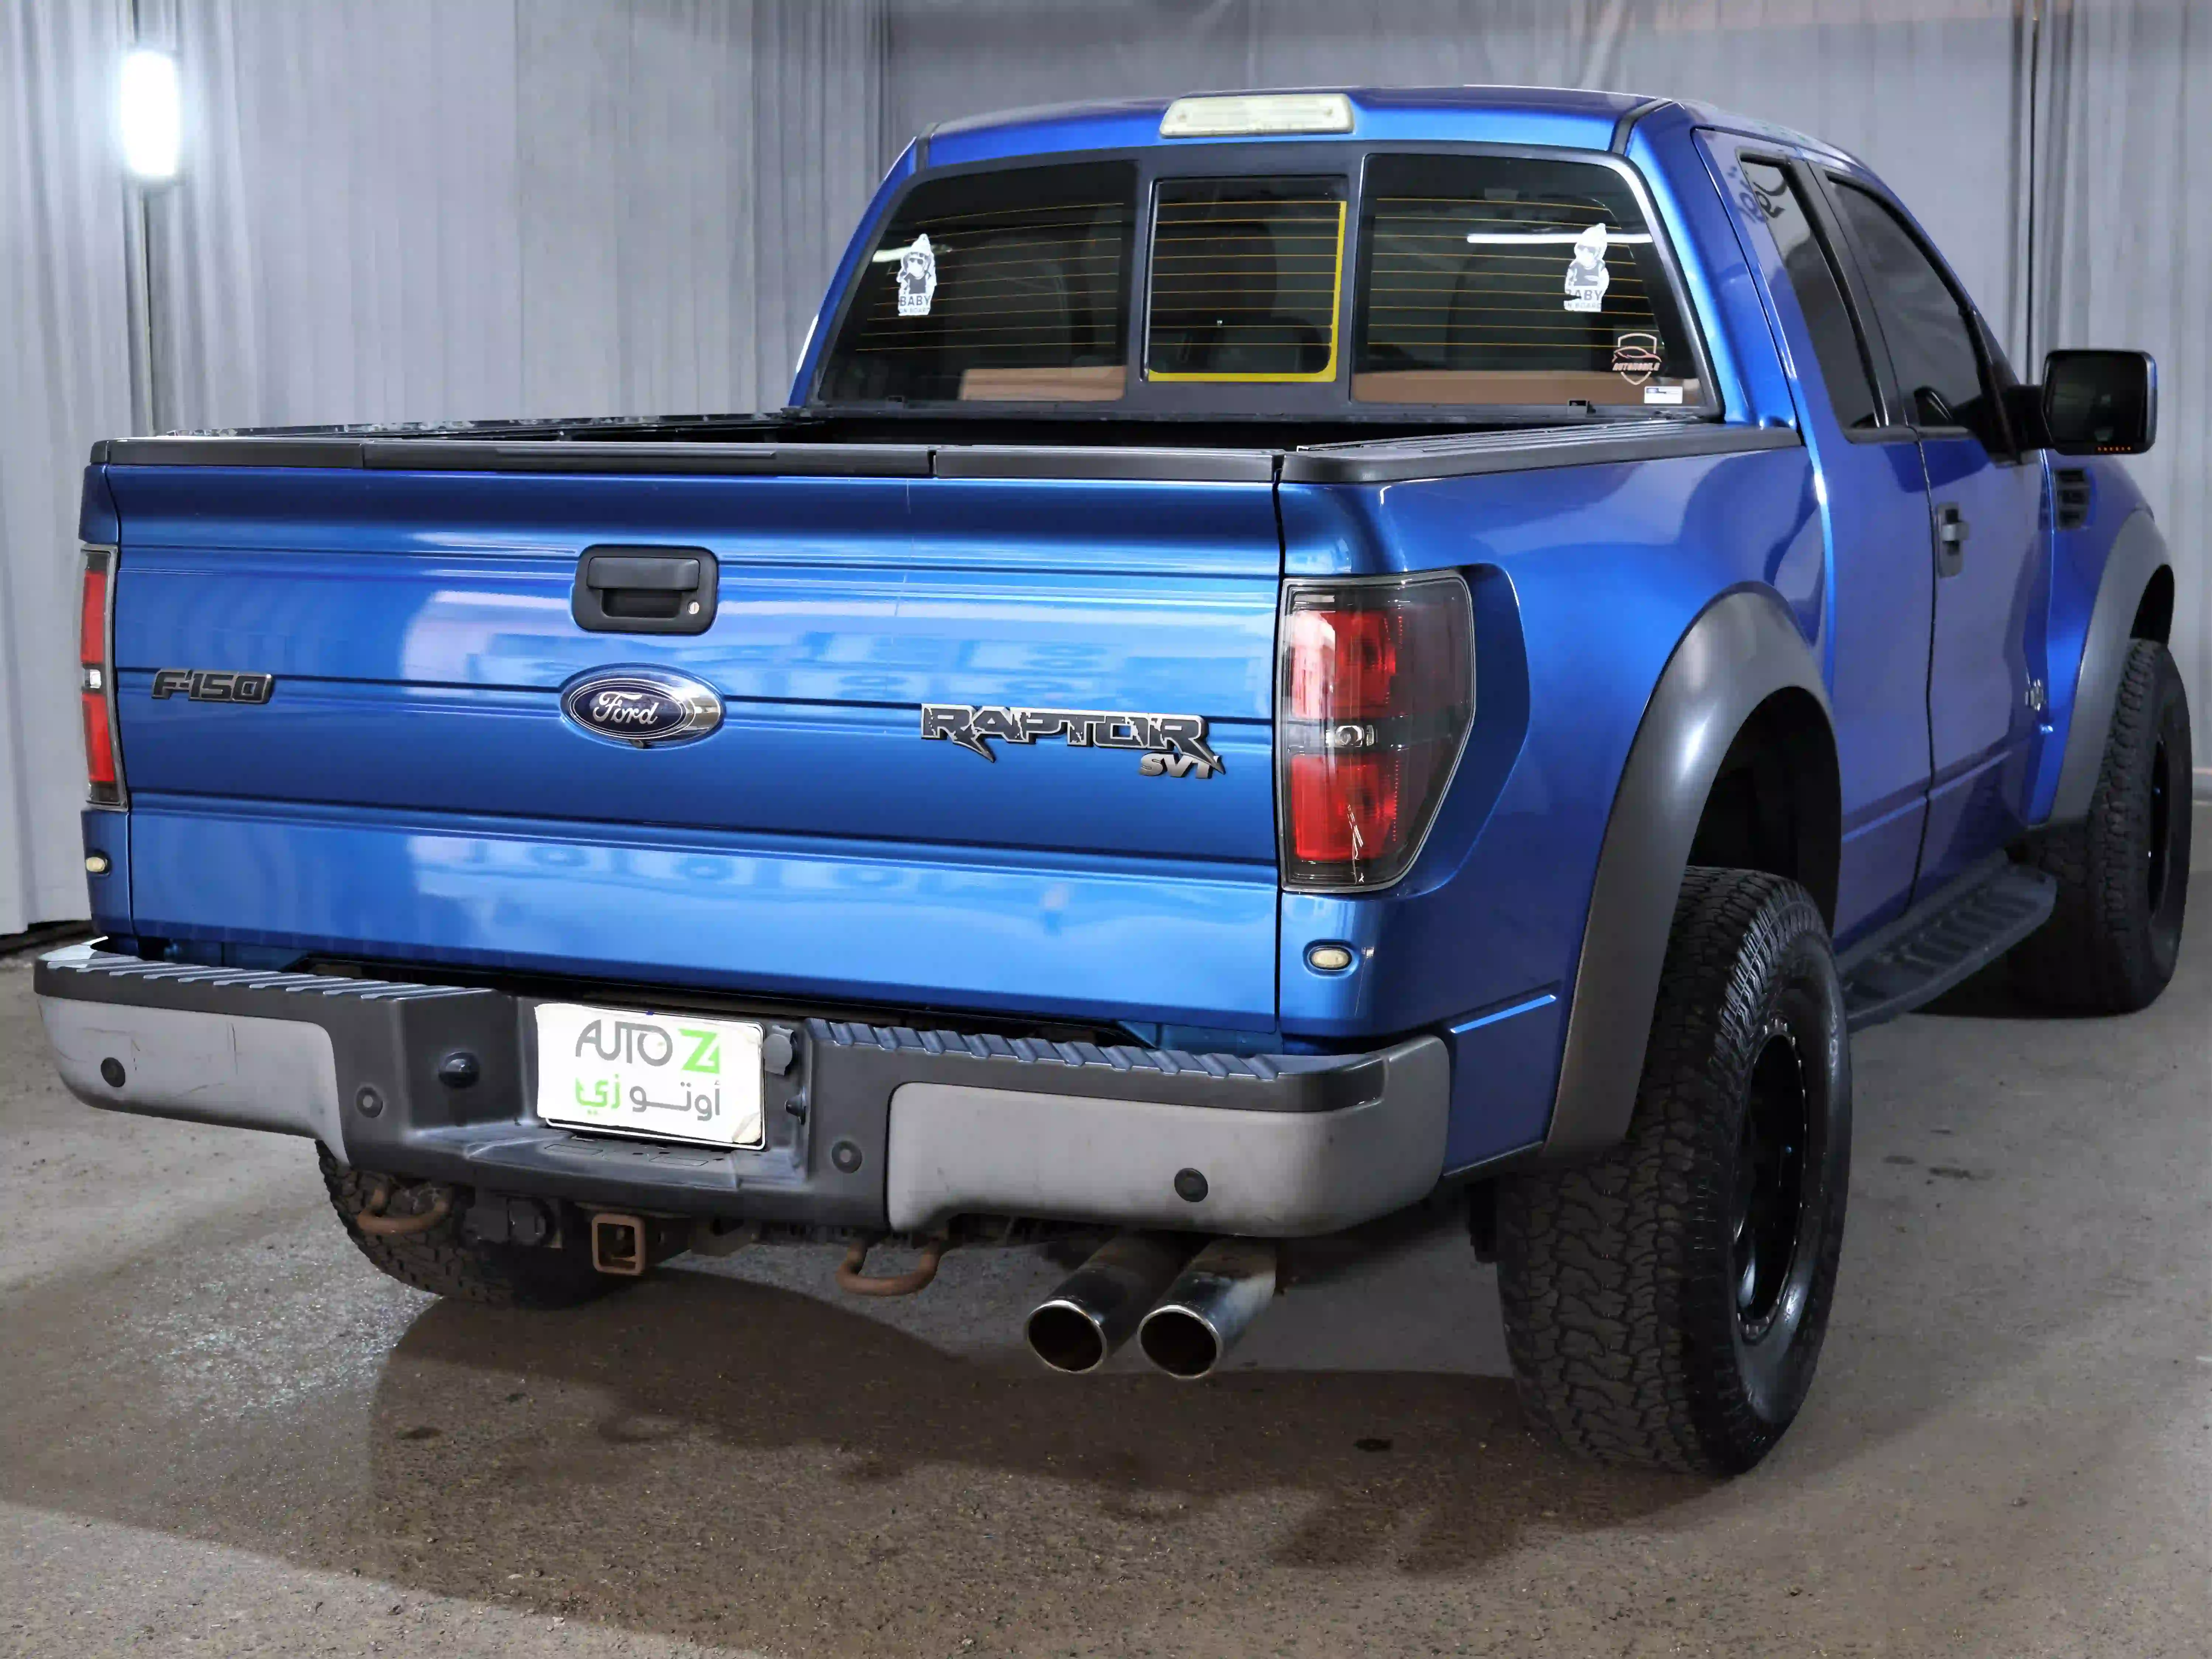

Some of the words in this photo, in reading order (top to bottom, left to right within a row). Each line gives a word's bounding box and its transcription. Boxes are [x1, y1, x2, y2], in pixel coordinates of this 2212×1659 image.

[900, 295, 931, 306] BABY
[592, 691, 658, 725] Ford
[921, 703, 1226, 775] RAPTOR
[1138, 752, 1222, 779] SVT
[575, 1019, 673, 1066] AUTO
[575, 1073, 621, 1115] زي
